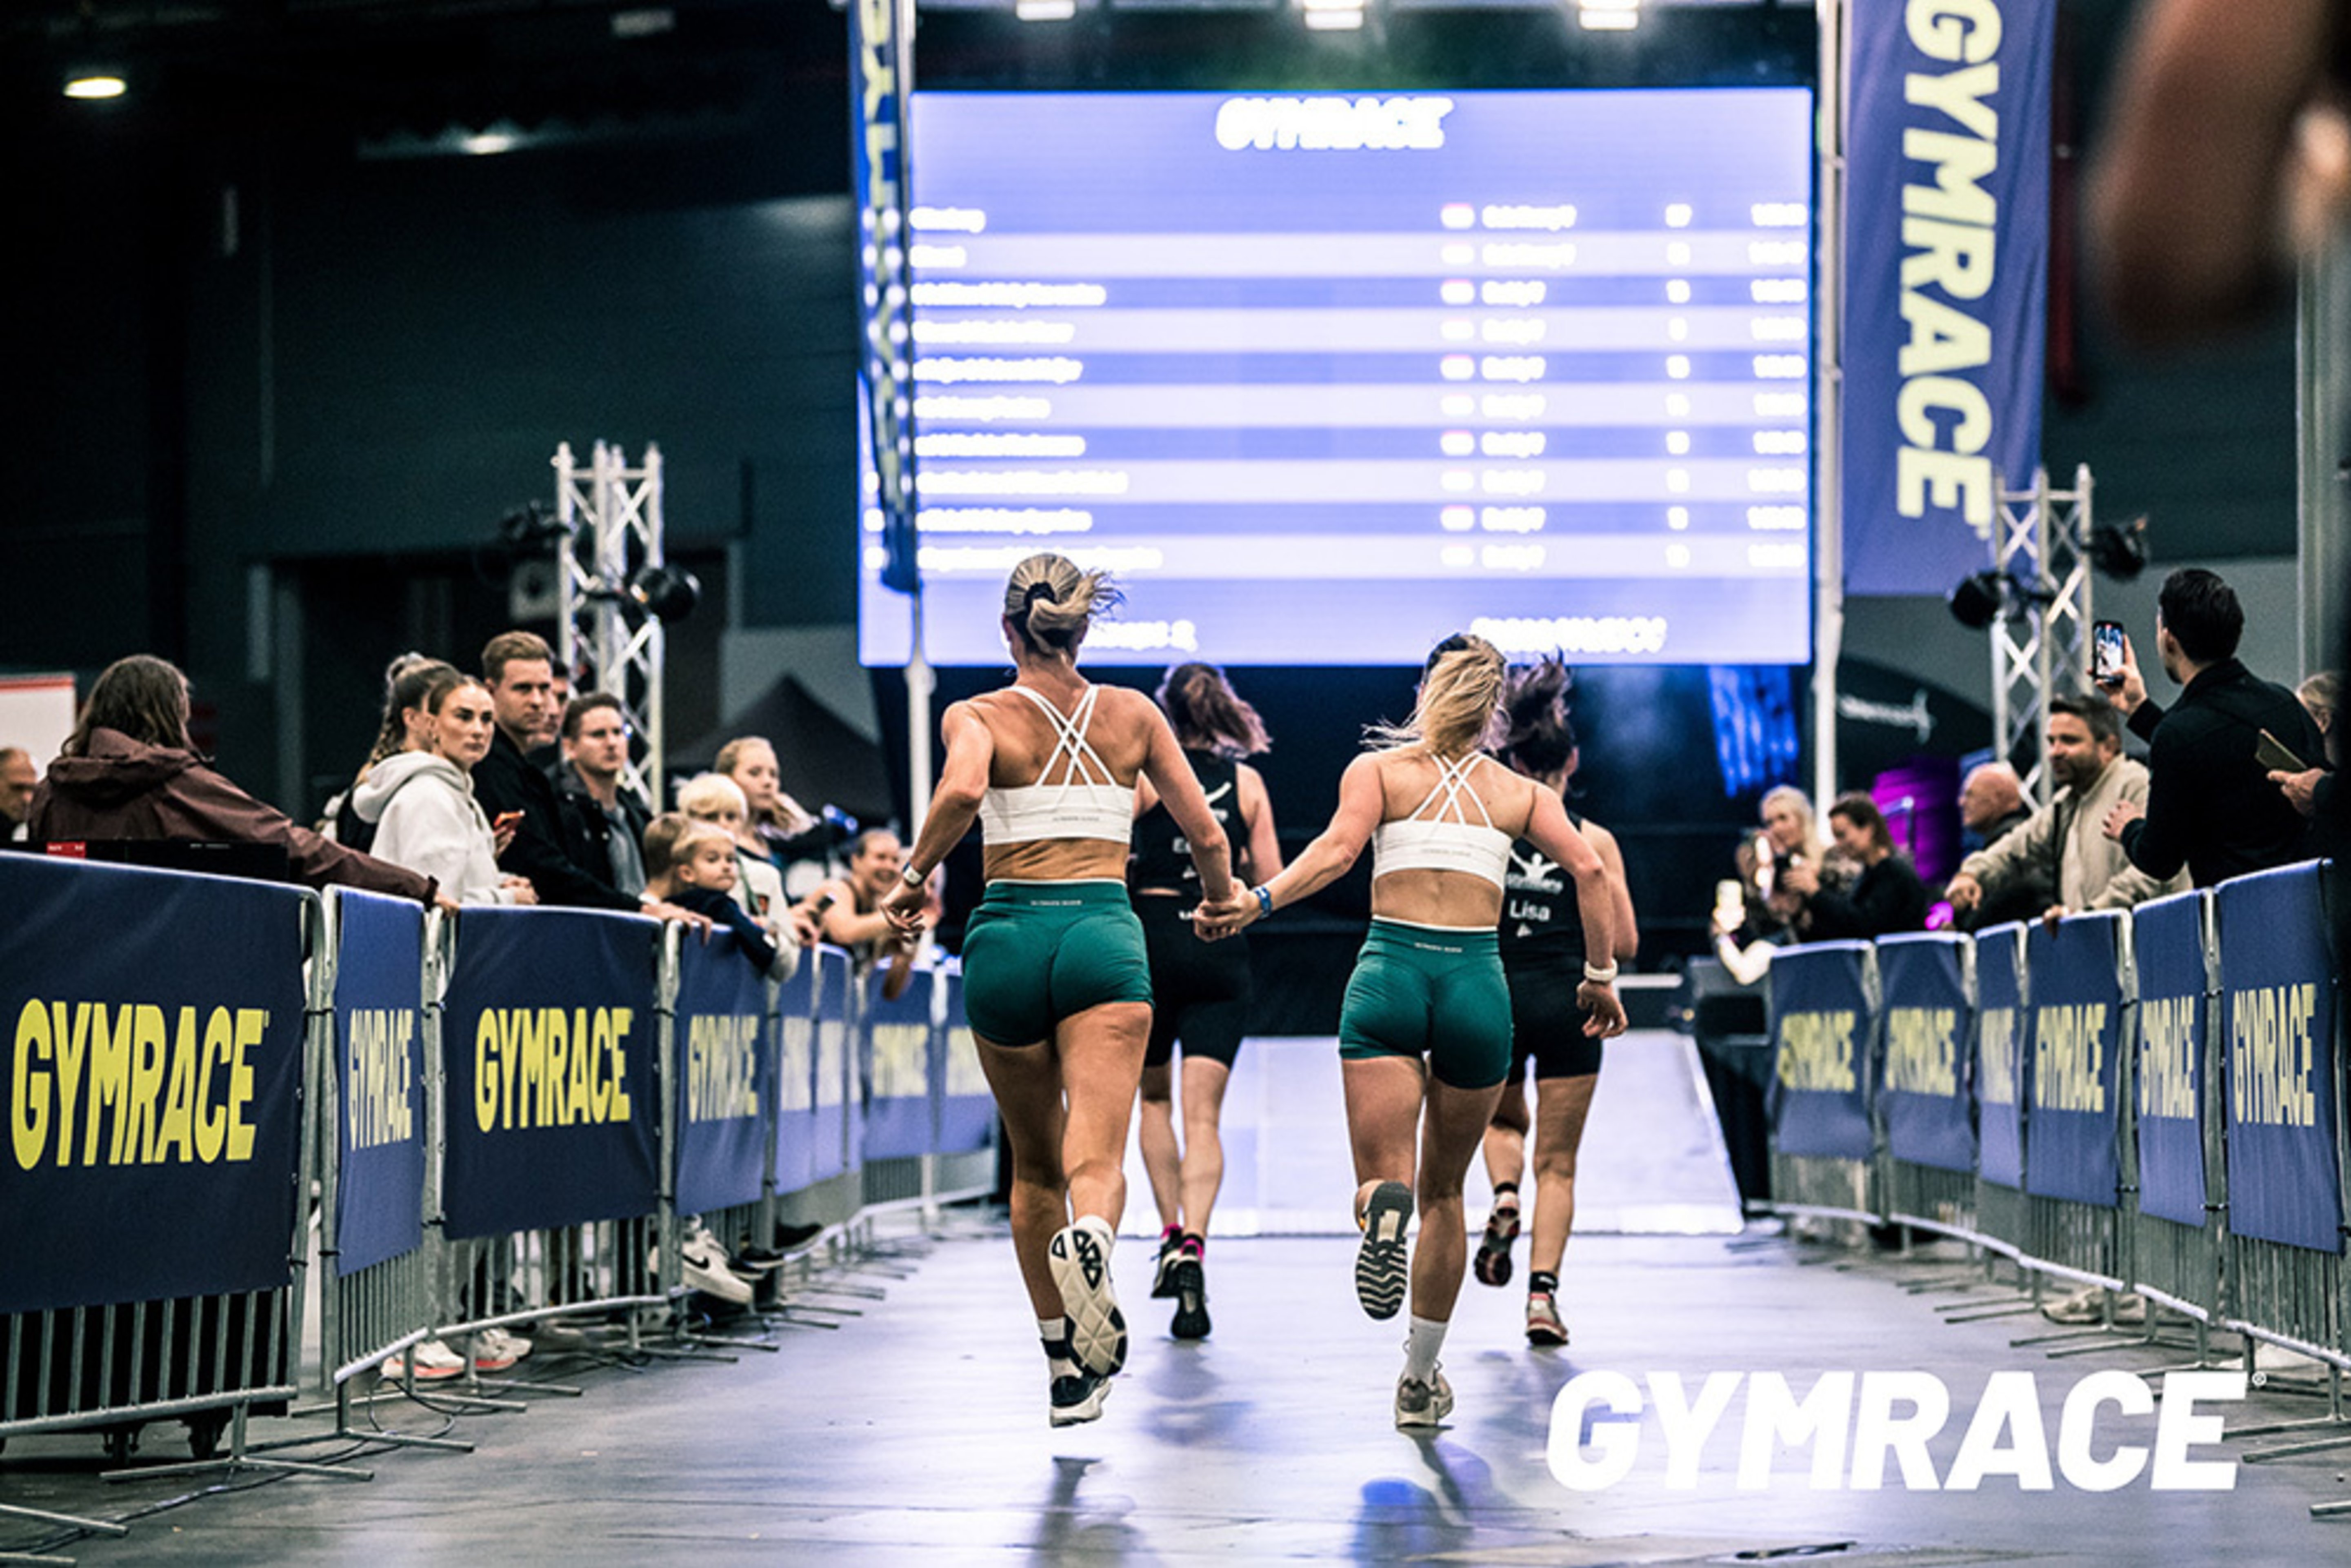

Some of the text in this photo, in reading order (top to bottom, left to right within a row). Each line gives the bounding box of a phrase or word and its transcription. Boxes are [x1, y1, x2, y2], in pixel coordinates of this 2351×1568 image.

[1897, 0, 2002, 526] GYMRACE
[1509, 900, 1550, 921] Lisa
[11, 998, 264, 1170] GYMRACE
[348, 1008, 414, 1151] GYMRACE
[475, 1006, 631, 1133] GYMRACE
[2233, 984, 2316, 1126] GYMRACE
